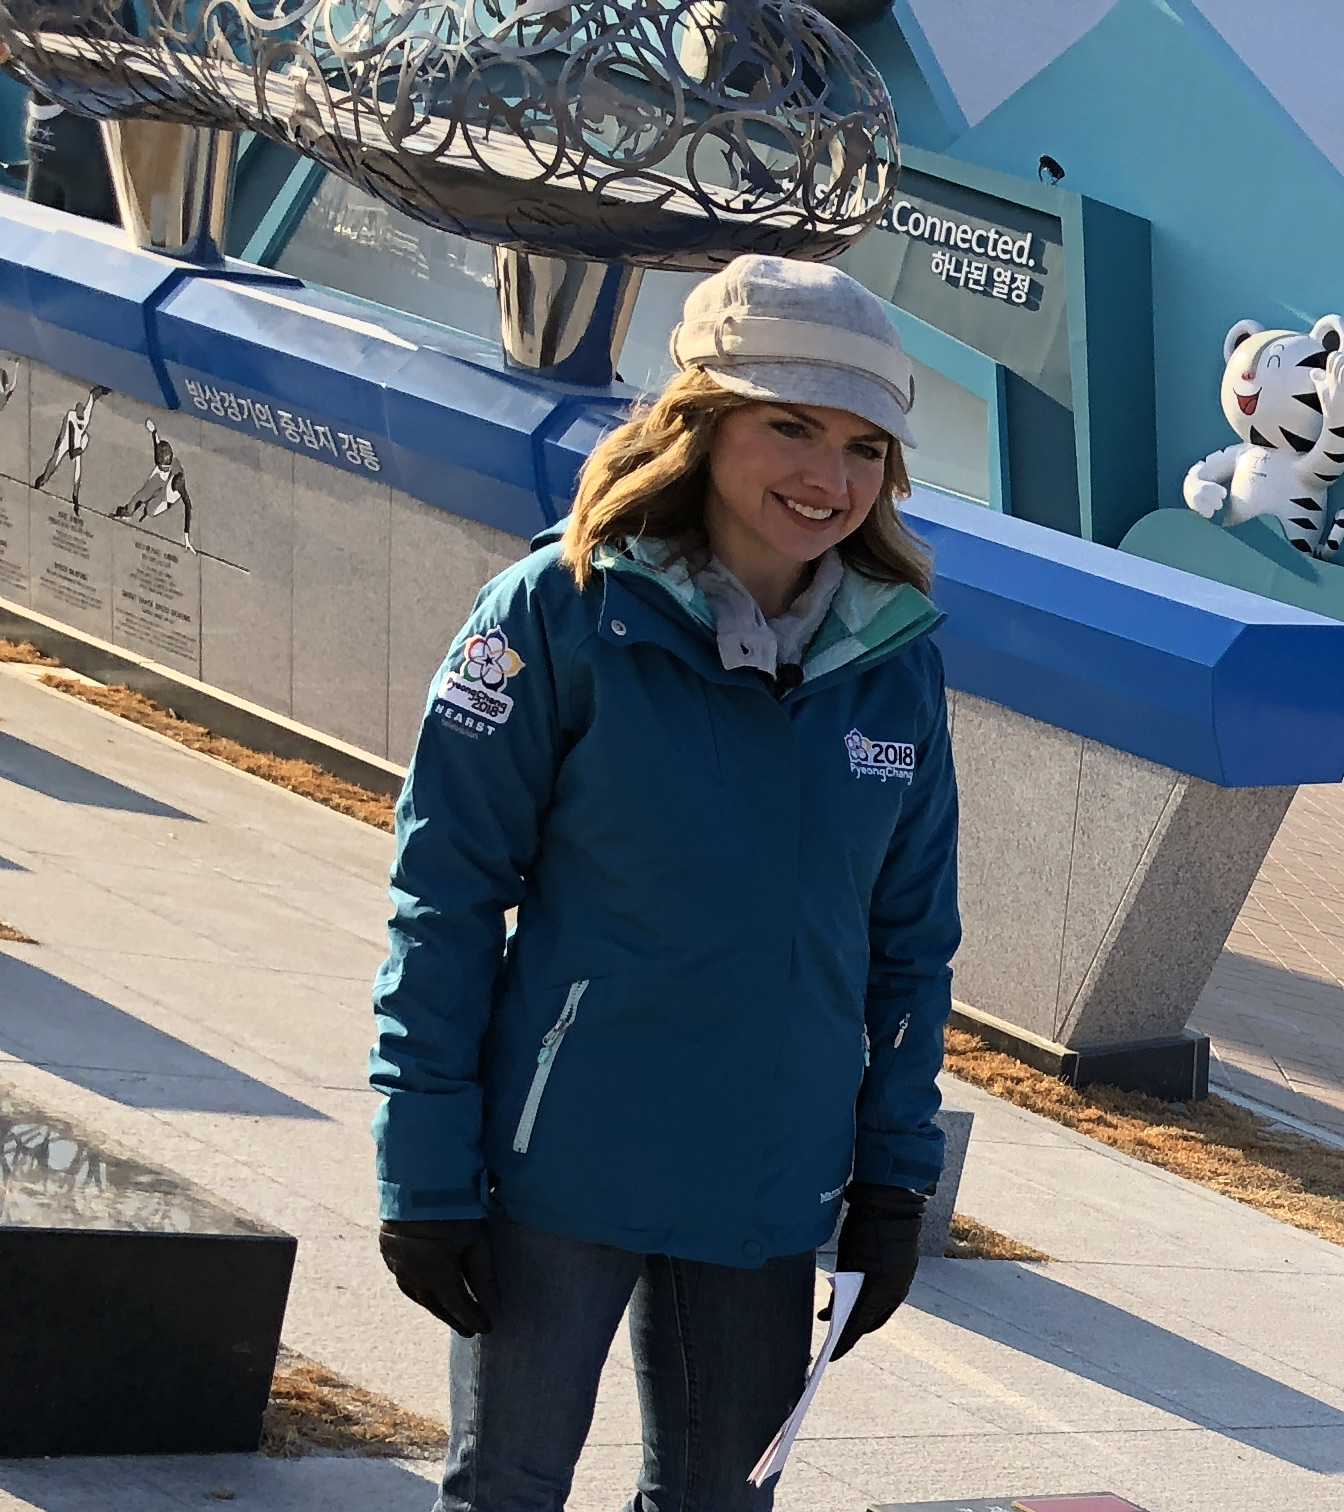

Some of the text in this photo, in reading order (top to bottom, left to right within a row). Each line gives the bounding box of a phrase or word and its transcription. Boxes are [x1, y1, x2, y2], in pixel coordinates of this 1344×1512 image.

[892, 201, 1036, 267] Connected.
[931, 251, 1031, 303] 하나된 열정
[184, 378, 381, 472] 빙상경기의 중심지 강릉
[434, 704, 496, 736] HEARST
[471, 702, 498, 718] 2018
[871, 743, 914, 767] 2018
[849, 762, 914, 786] PyeongChang
